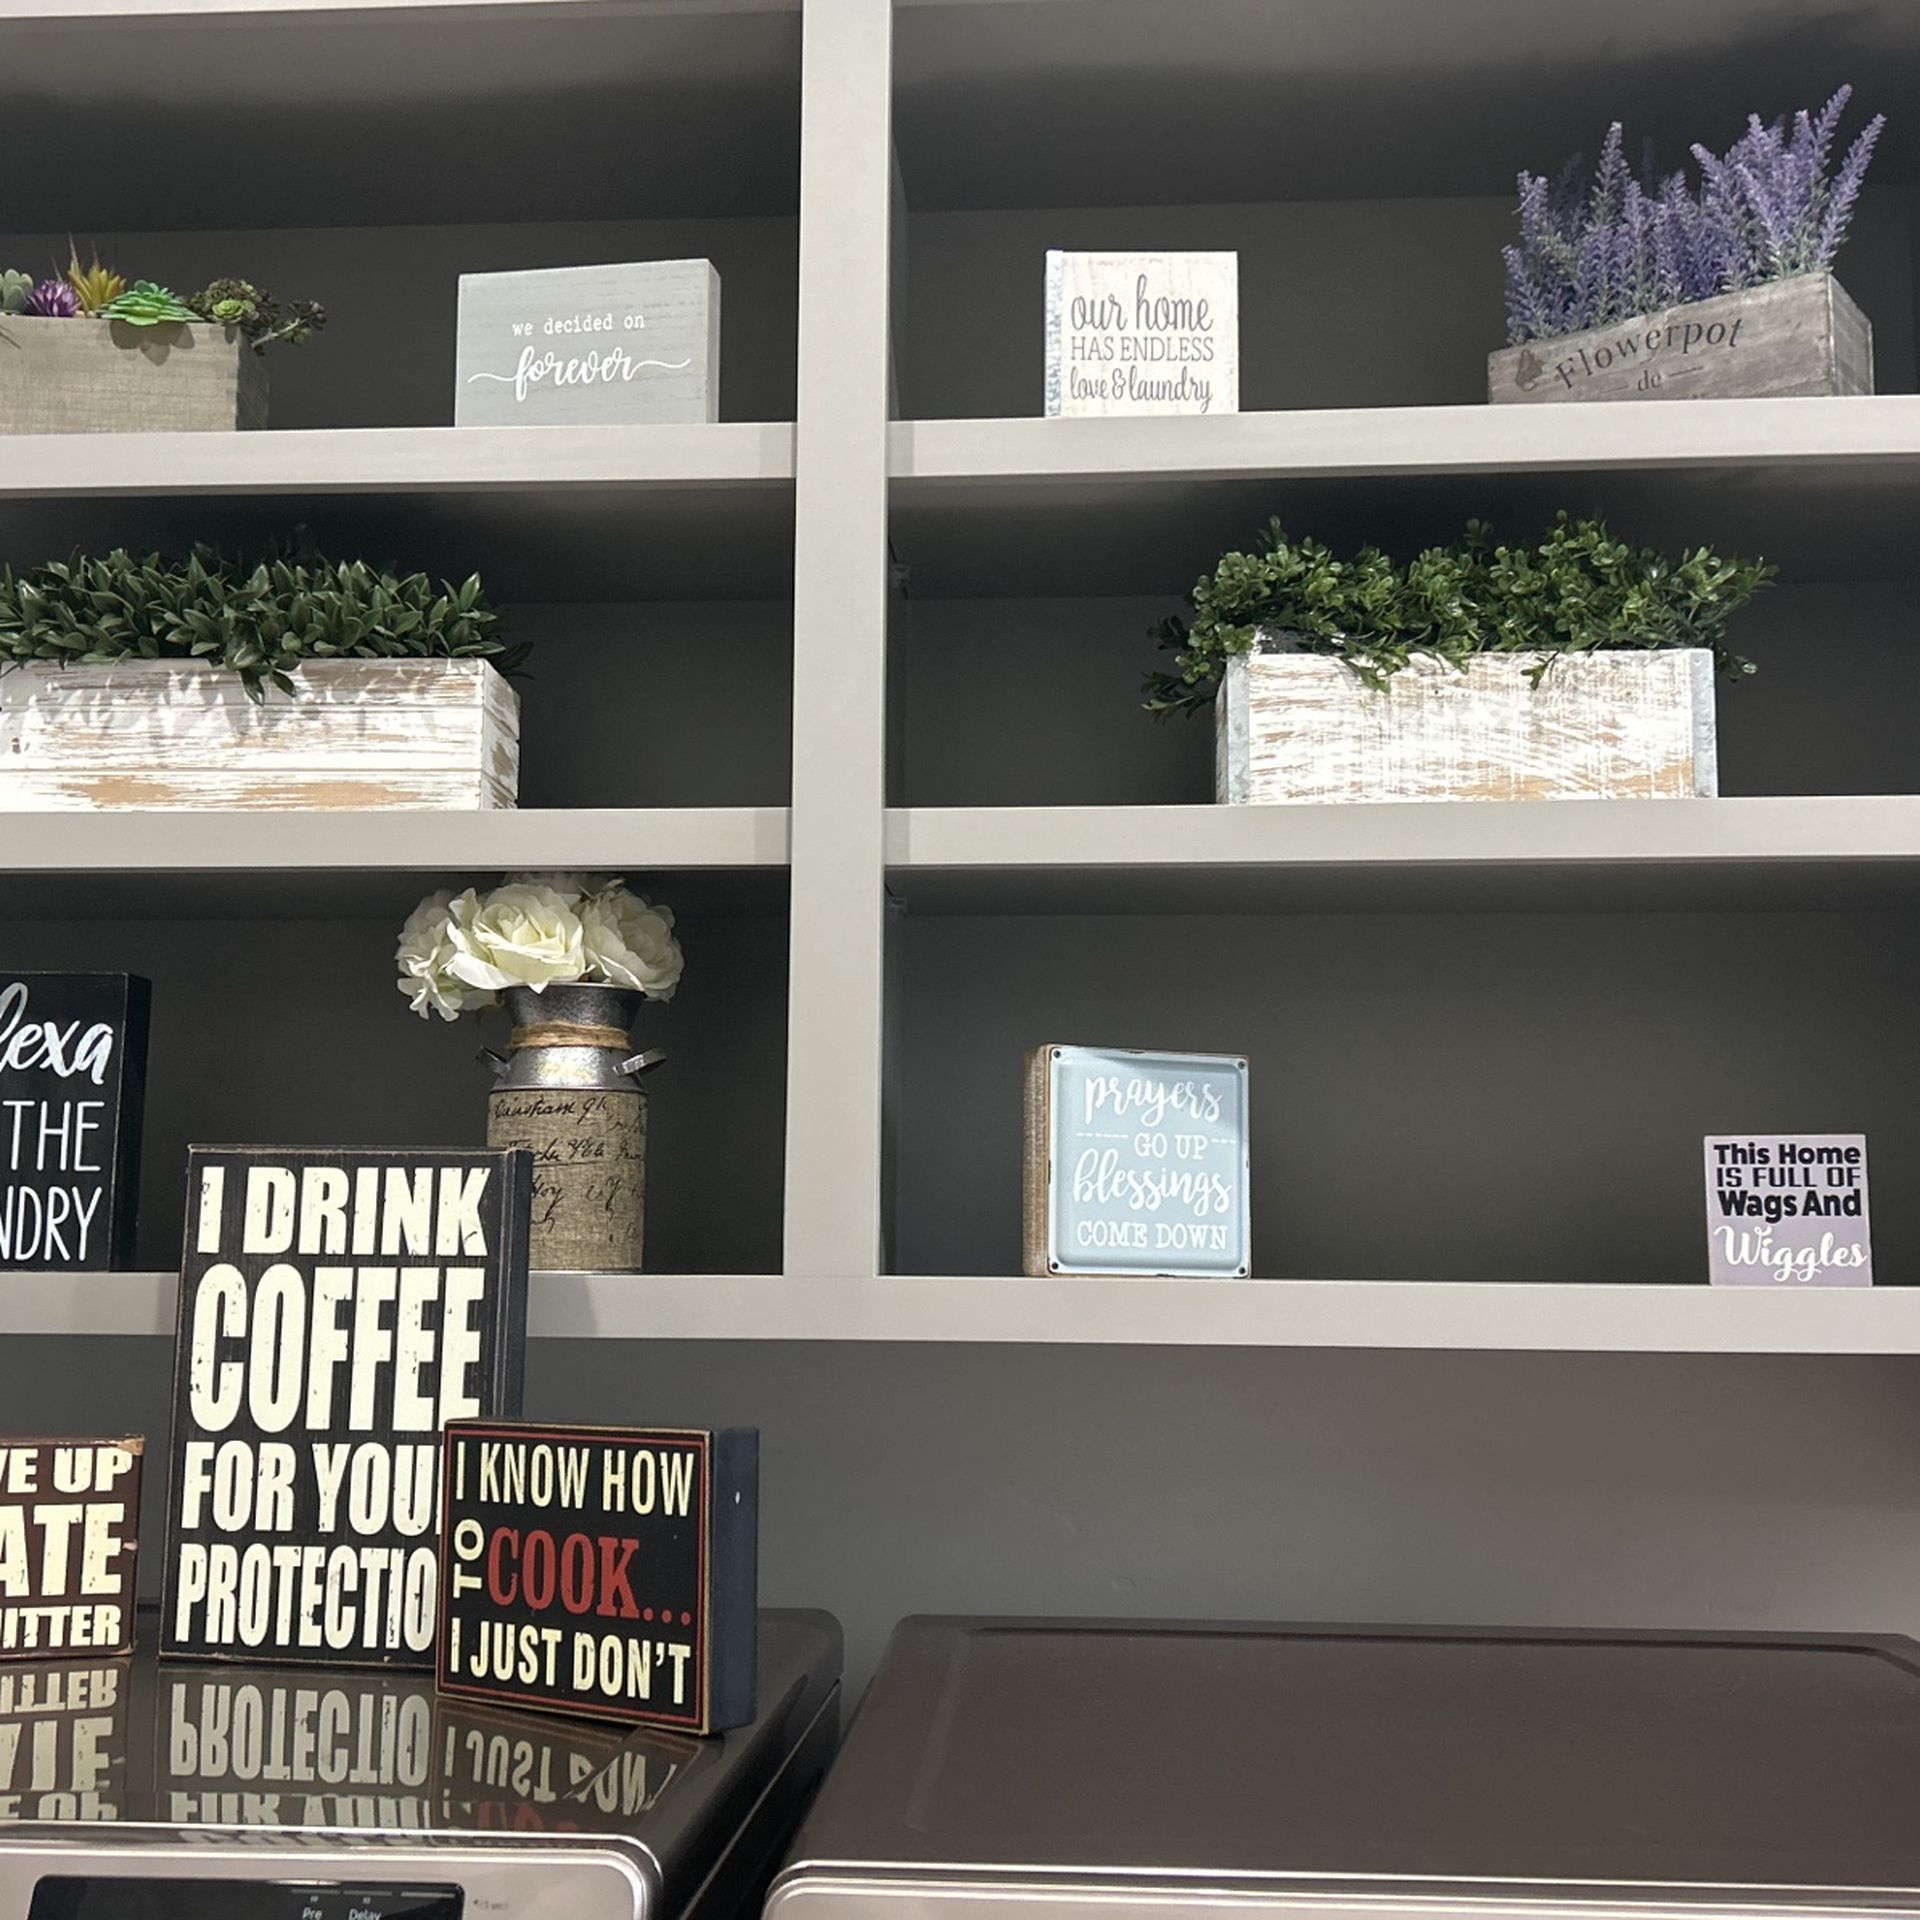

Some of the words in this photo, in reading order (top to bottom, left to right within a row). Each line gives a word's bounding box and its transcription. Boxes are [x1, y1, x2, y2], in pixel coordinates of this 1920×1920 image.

[512, 321, 533, 337] we
[544, 313, 613, 335] decided
[624, 314, 646, 329] on
[1071, 293, 1128, 332] our
[1136, 274, 1214, 332] home
[467, 346, 691, 401] forever
[1071, 336, 1114, 361] HAS
[1120, 336, 1214, 362] ENDLESS
[1555, 317, 1743, 390] Flowerpot
[1638, 370, 1662, 392] de
[1085, 1076, 1223, 1127] prayers
[2, 1100, 105, 1172] THE
[1134, 1133, 1167, 1158] GO
[1174, 1134, 1208, 1160] UP
[1714, 1142, 1770, 1165] This
[1779, 1144, 1861, 1165] Home
[1073, 1148, 1232, 1217] blessings
[1717, 1167, 1742, 1187] IS
[1753, 1167, 1817, 1187] FULL
[1827, 1167, 1861, 1187] OF
[197, 1166, 225, 1254] I
[243, 1166, 491, 1257] DRINK
[1717, 1190, 1797, 1224] Wags
[1802, 1188, 1862, 1216] And
[1077, 1220, 1148, 1248] COME
[1155, 1223, 1228, 1250] DOWN
[1714, 1226, 1867, 1282] Wiggles
[190, 1263, 485, 1433] COFFEE
[53, 1447, 134, 1494] UP
[181, 1440, 297, 1532] FOR
[312, 1442, 444, 1537] YOU
[456, 1441, 465, 1500] I
[480, 1442, 590, 1509] KNOW
[602, 1449, 694, 1517] HOW
[453, 1519, 485, 1599] TO
[487, 1526, 692, 1627] COOK...
[175, 1543, 438, 1652] PROTECTIO
[0, 1604, 122, 1649] ITTER
[450, 1617, 460, 1673] I
[470, 1620, 562, 1686] JUST
[573, 1632, 691, 1705] DON'T
[302, 1907, 323, 1919] Pre
[348, 1908, 382, 1920] Delay
